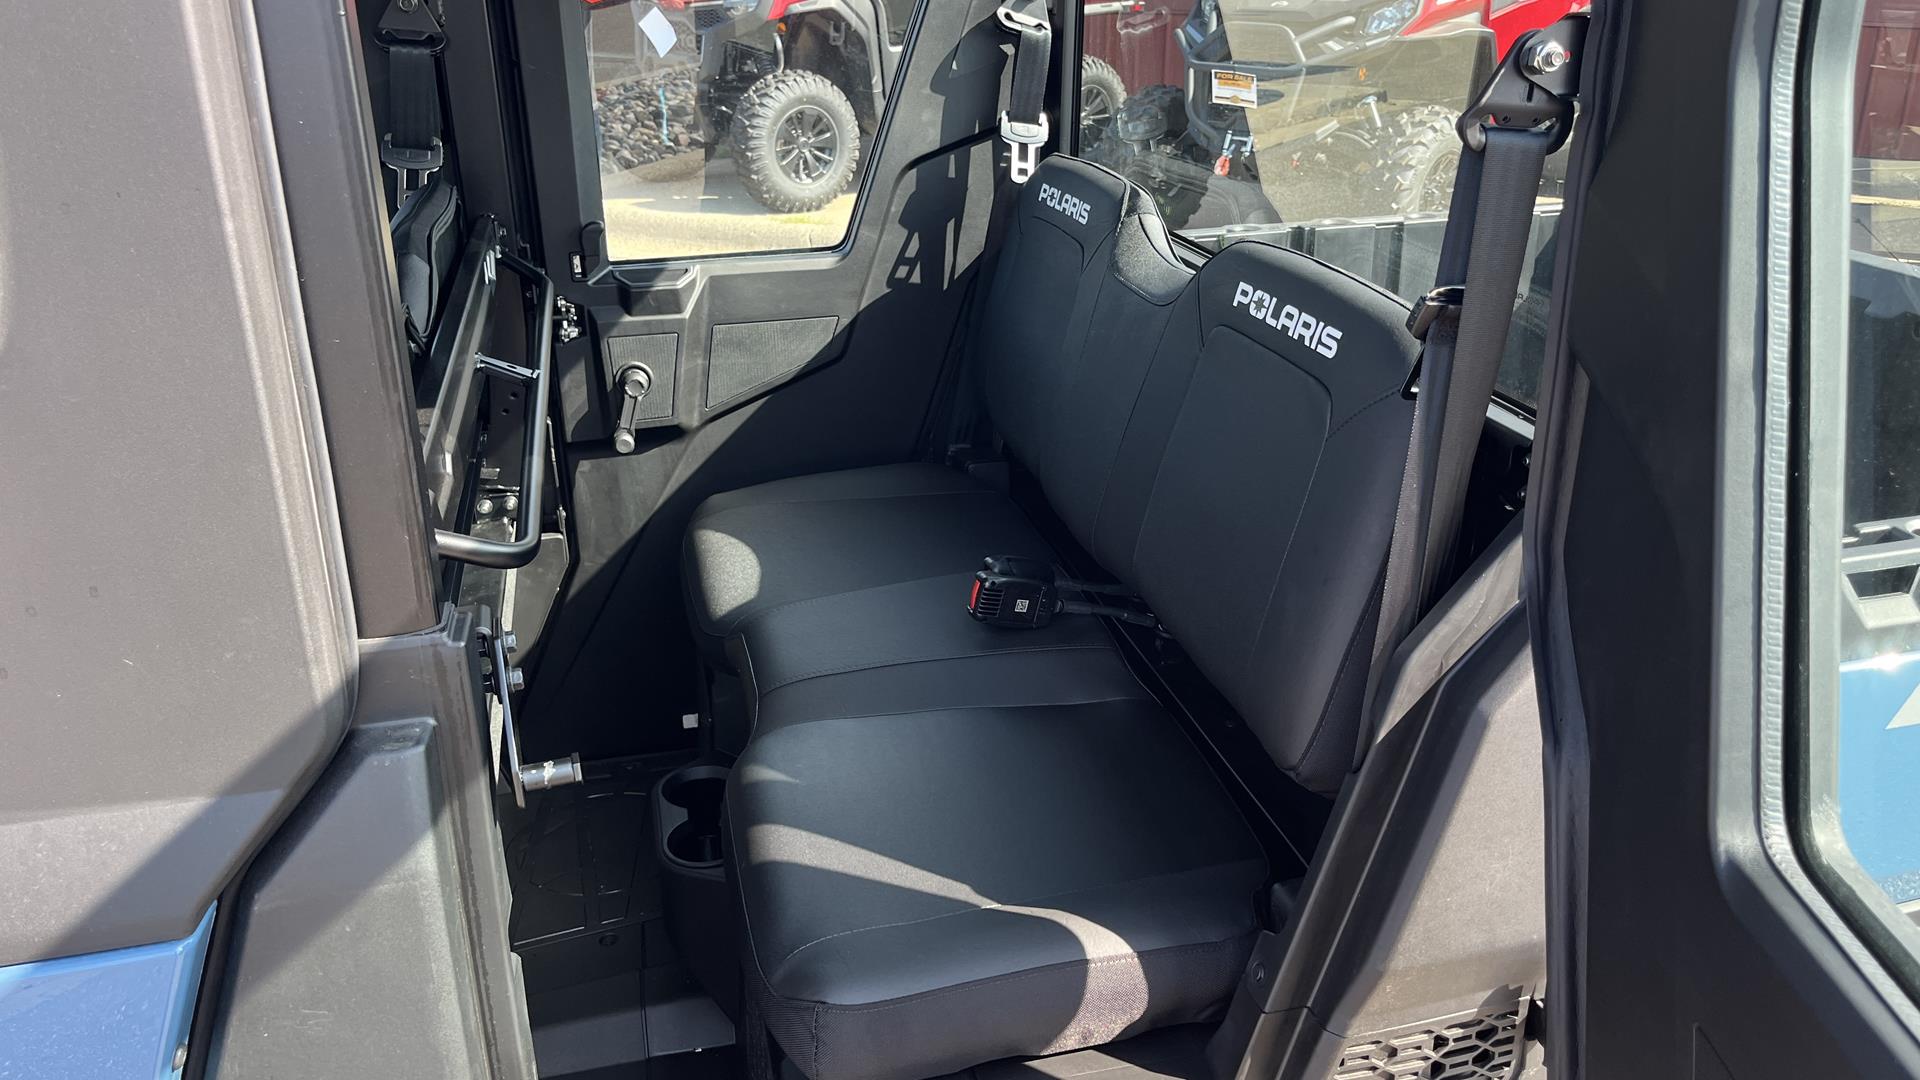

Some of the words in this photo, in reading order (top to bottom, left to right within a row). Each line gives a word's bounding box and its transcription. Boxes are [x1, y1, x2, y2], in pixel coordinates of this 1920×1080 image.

[1233, 74, 1253, 82] SALE
[1038, 183, 1091, 225] POLARIS
[1232, 281, 1343, 359] POLARIS
